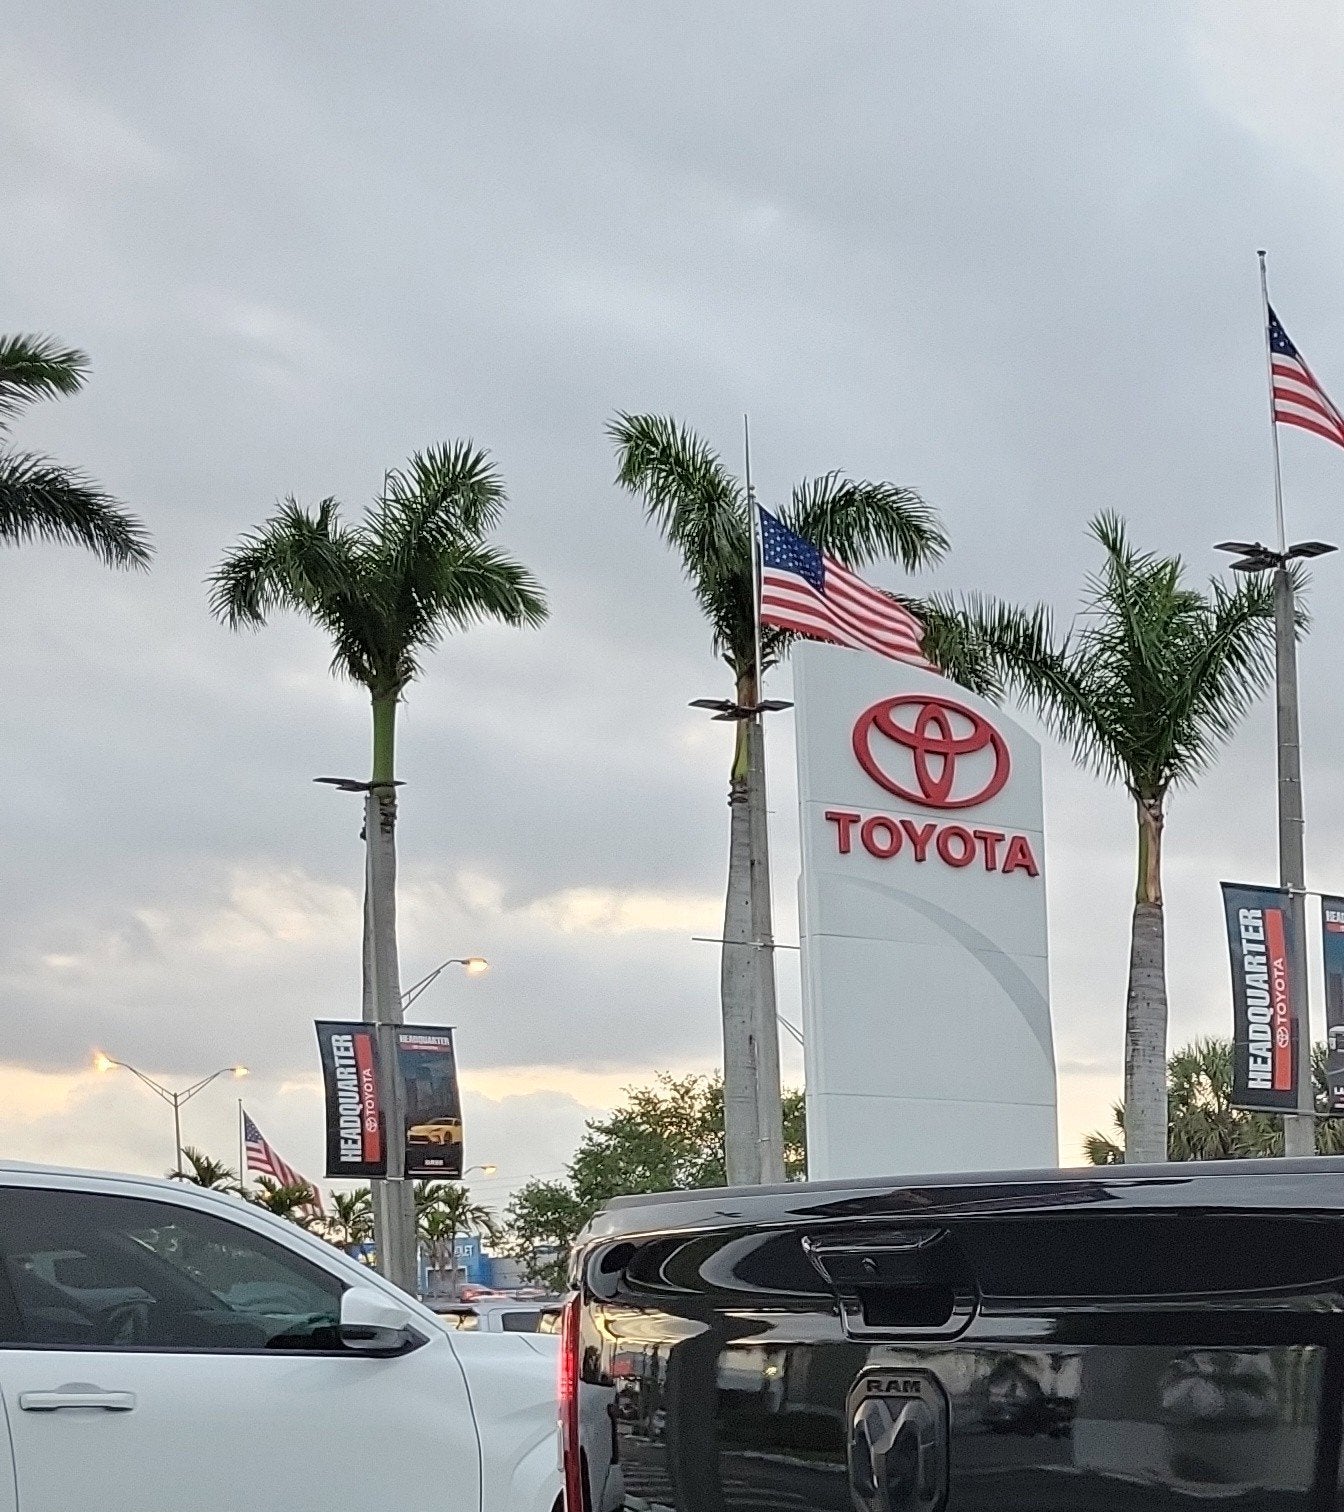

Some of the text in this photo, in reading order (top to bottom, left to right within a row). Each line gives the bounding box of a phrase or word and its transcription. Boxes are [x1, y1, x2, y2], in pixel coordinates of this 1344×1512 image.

[825, 811, 1040, 877] TOYOTA
[1239, 908, 1273, 1090] HEADQUARTER
[1273, 957, 1288, 1025] TOYOTA
[331, 1034, 363, 1163] HEADQUARTER
[363, 1068, 377, 1116] TOYOTA
[866, 1379, 922, 1393] RAM
